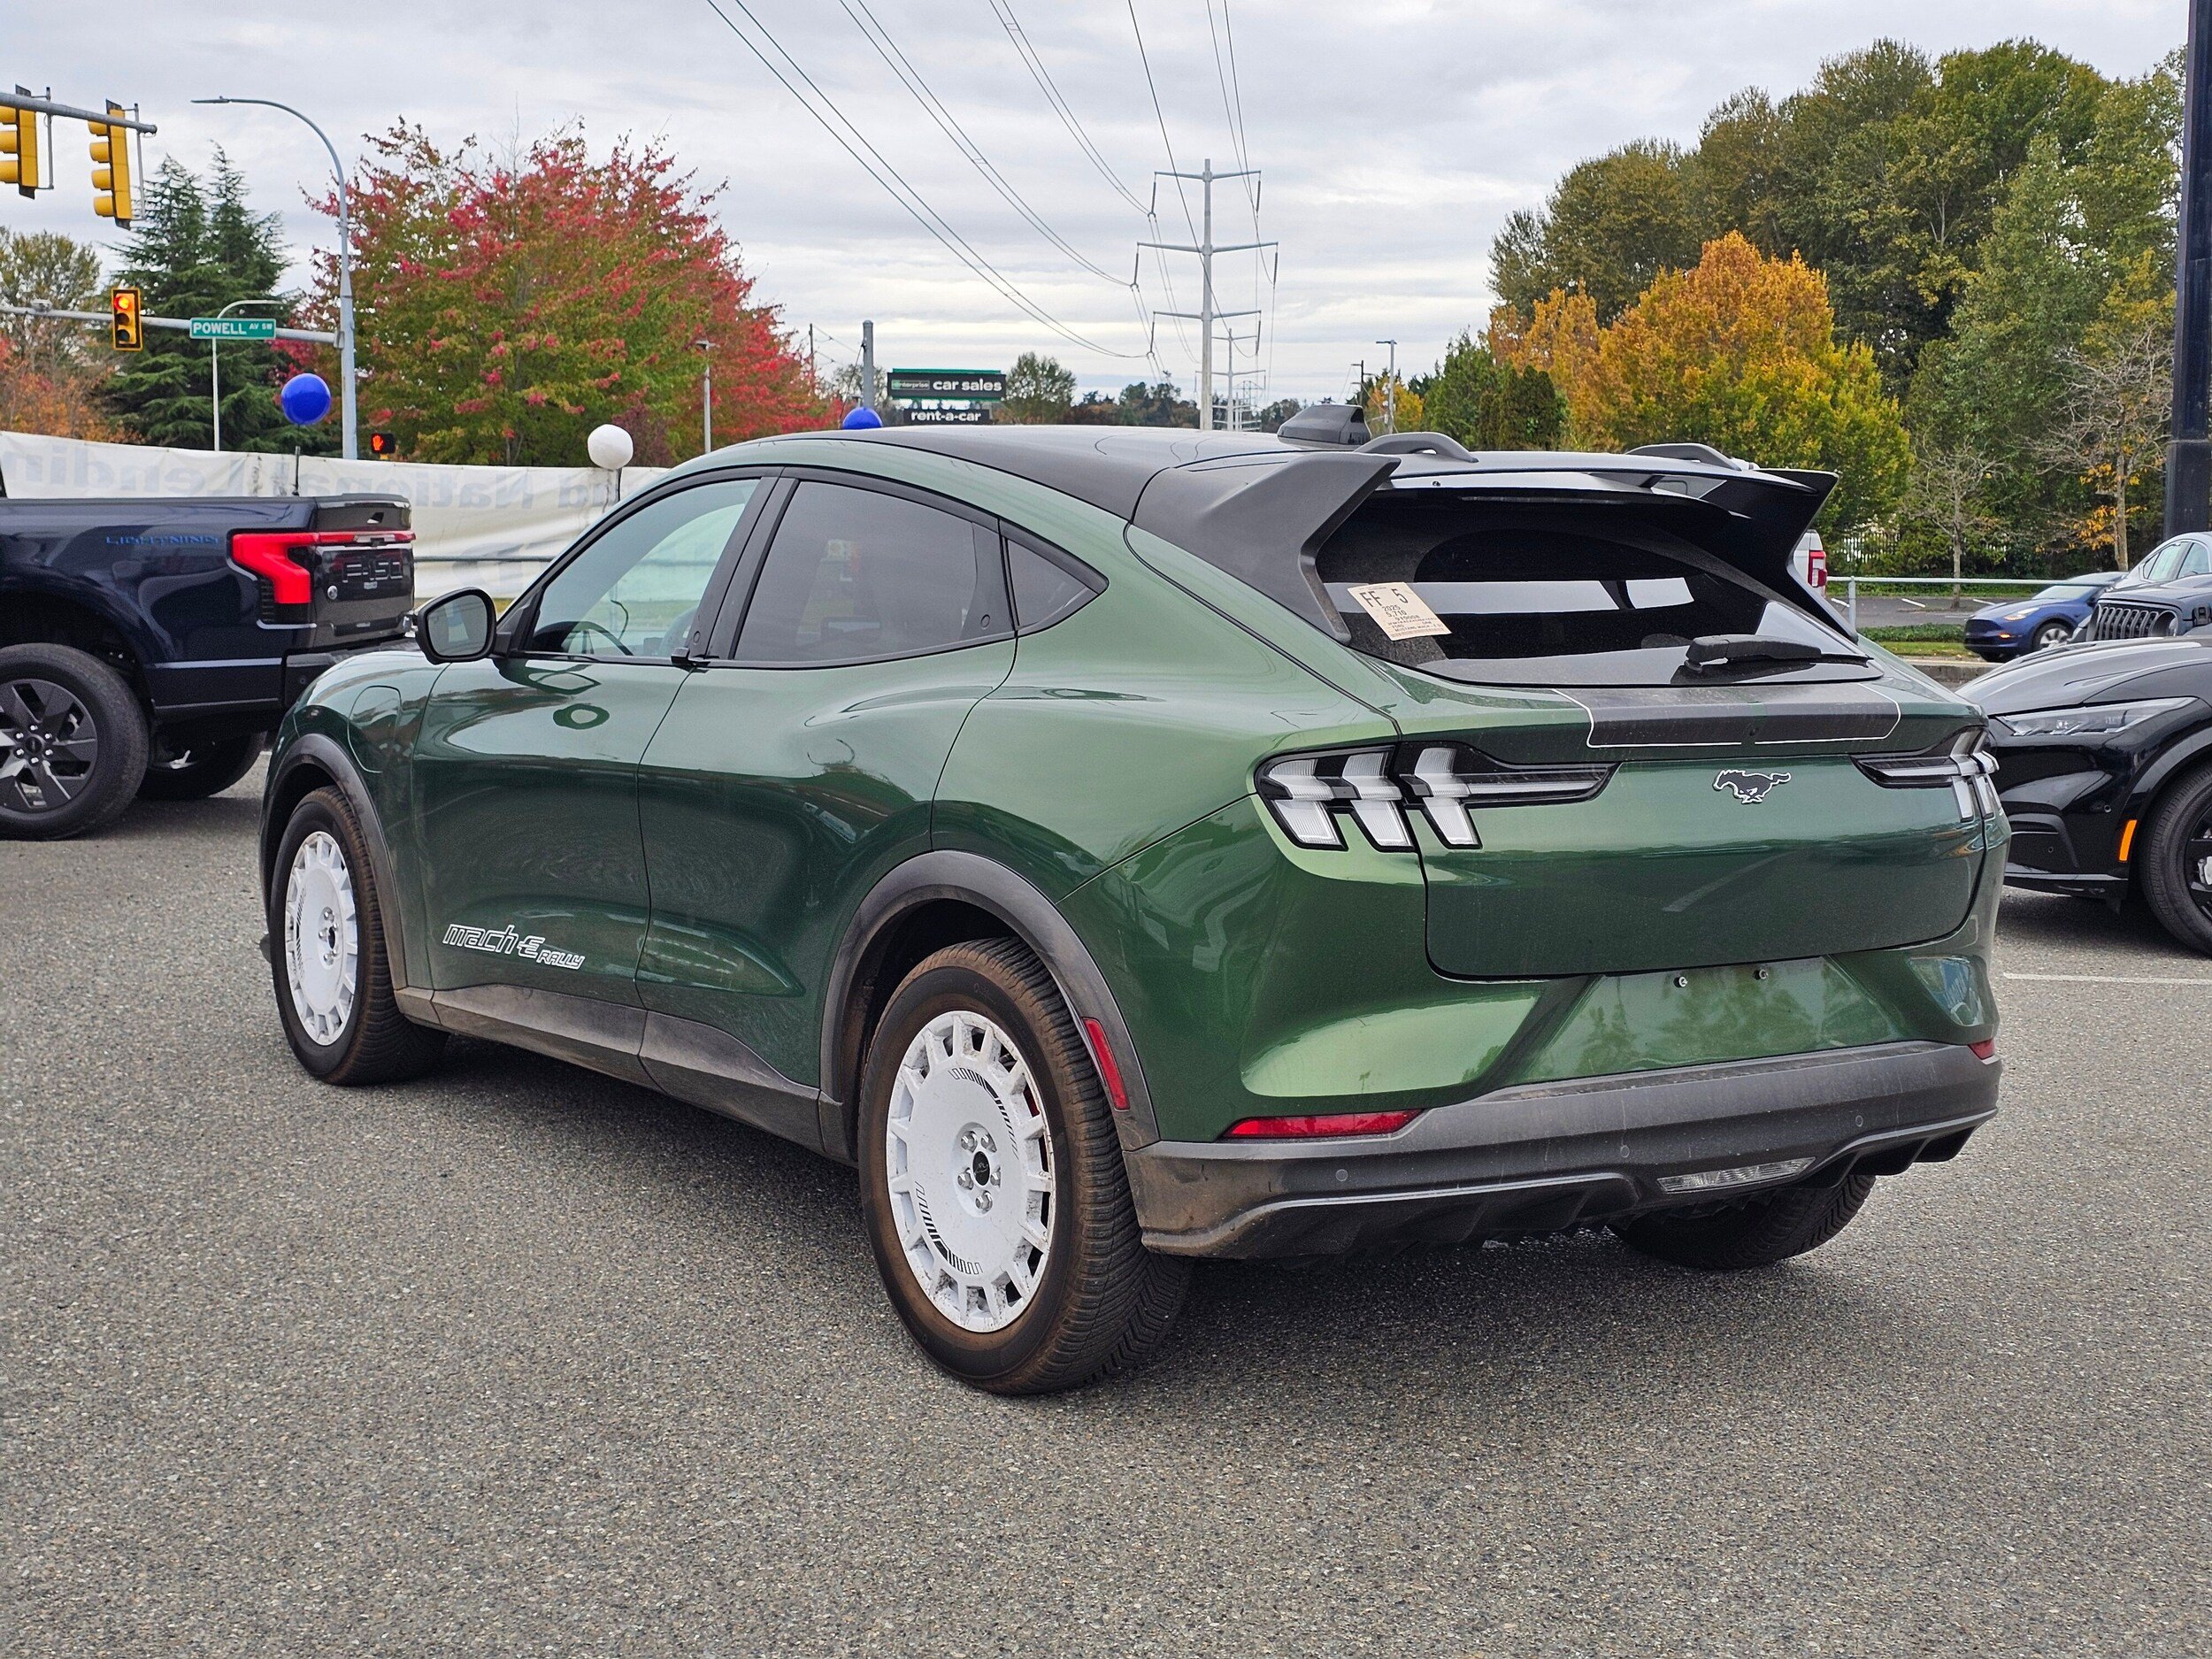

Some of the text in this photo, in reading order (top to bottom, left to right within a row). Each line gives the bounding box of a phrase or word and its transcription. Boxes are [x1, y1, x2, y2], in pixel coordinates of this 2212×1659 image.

[193, 322, 247, 334] POWELL
[933, 380, 959, 391] car
[961, 378, 1002, 391] sales
[910, 411, 981, 421] rent-a-car
[106, 535, 219, 546] LIGHTNING
[1359, 588, 1409, 608] FF 5
[536, 949, 585, 970] RALLY
